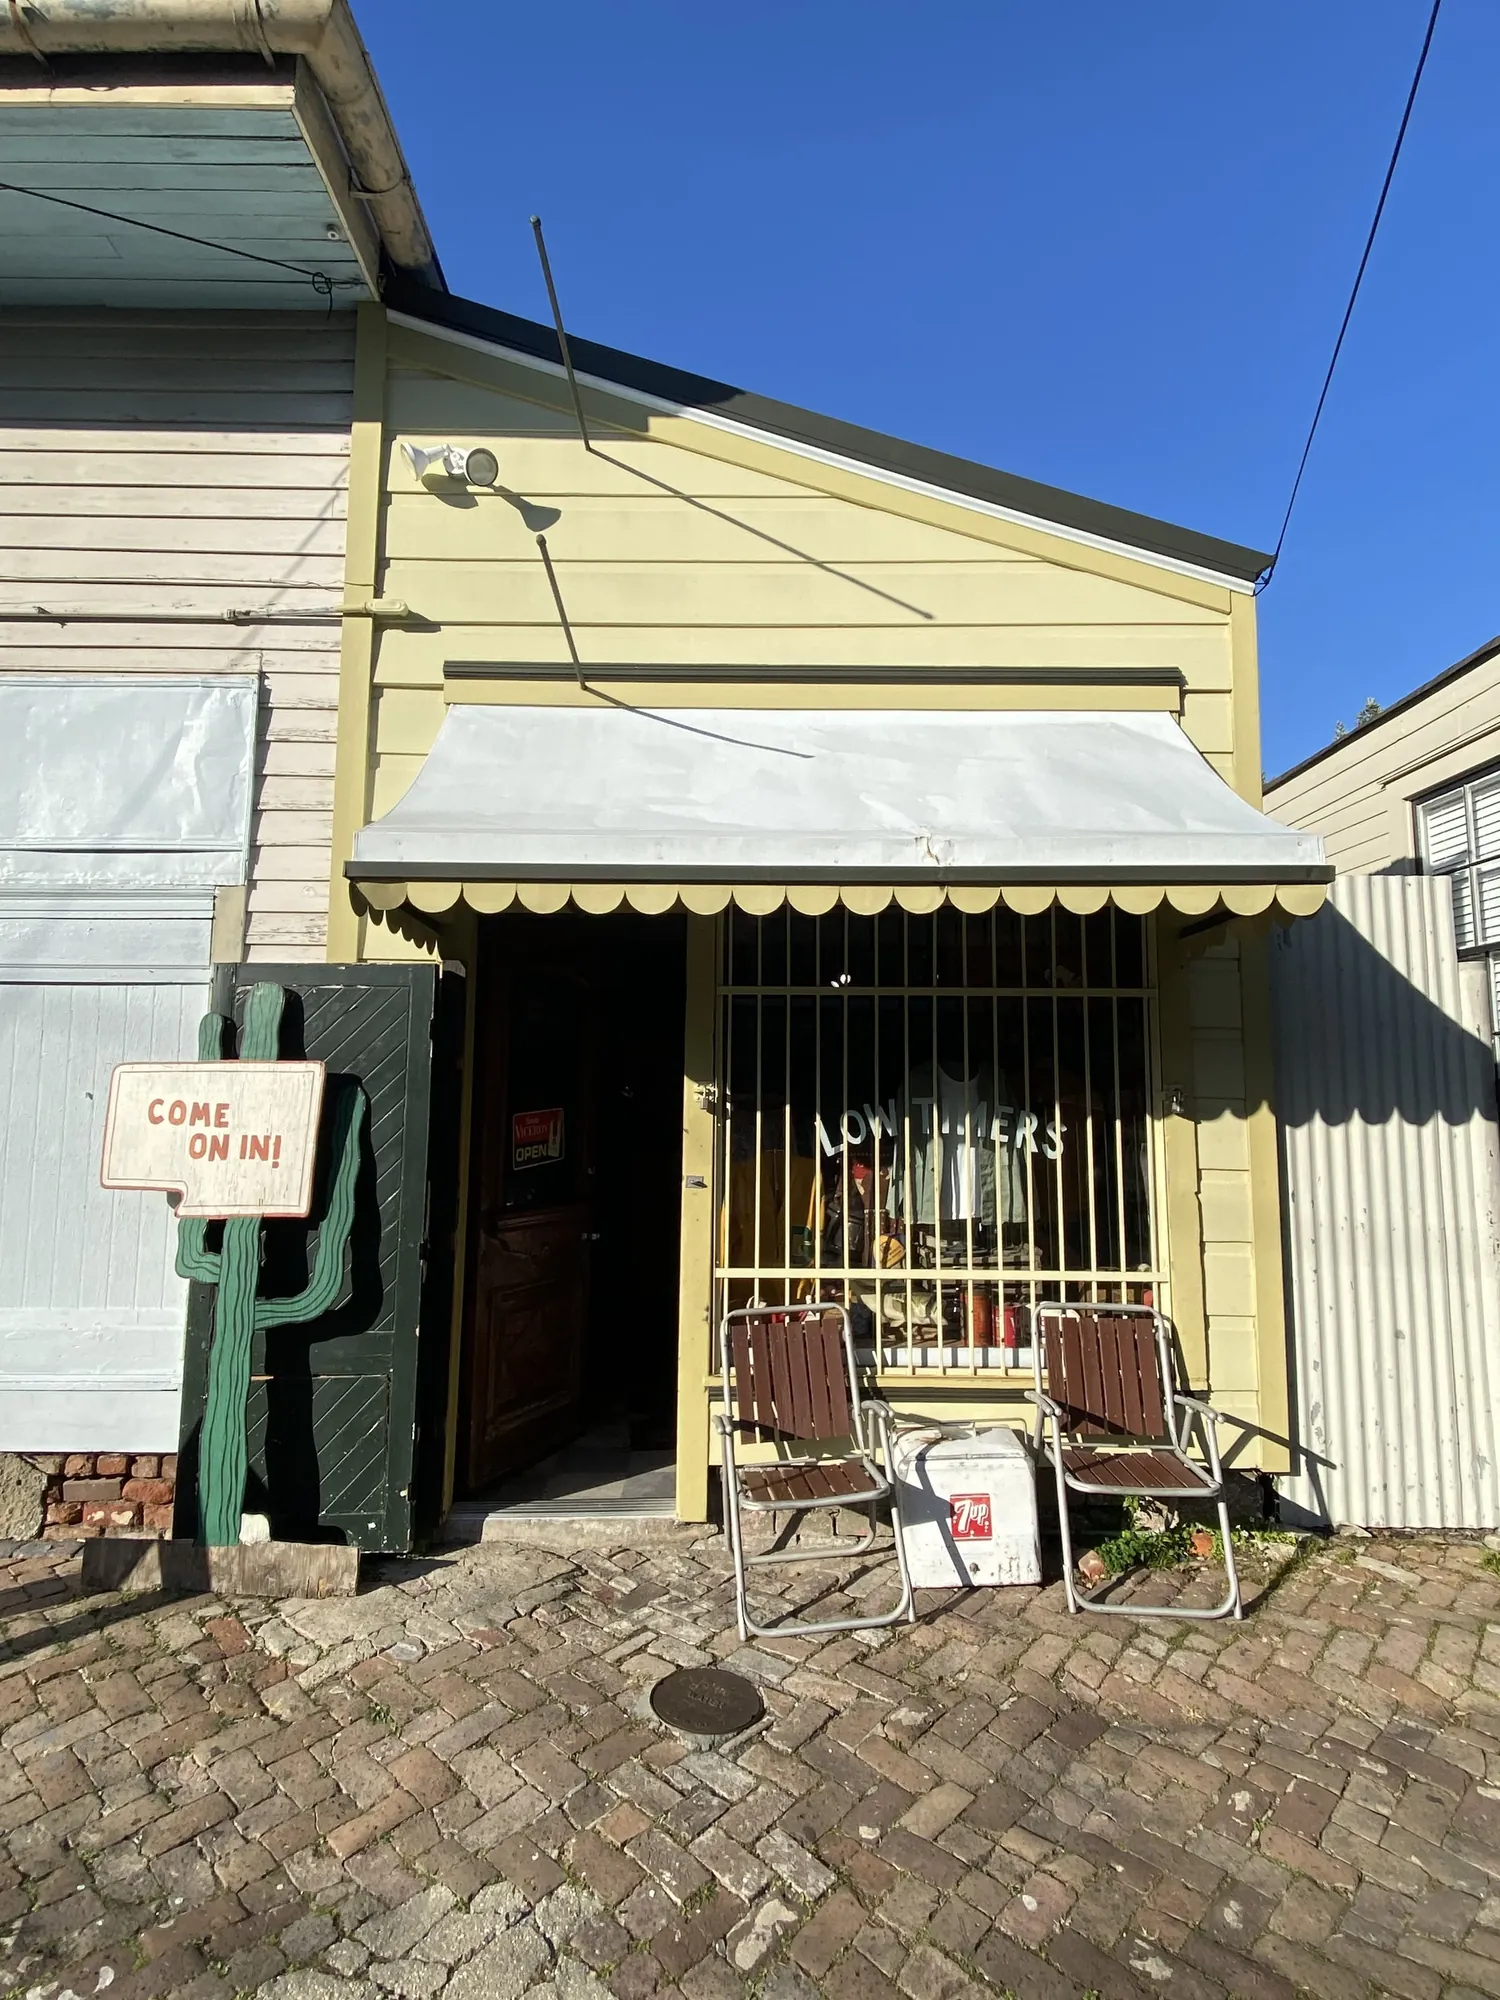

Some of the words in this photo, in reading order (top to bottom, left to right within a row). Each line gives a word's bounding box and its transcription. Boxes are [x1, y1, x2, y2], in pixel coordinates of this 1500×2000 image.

[147, 1098, 230, 1128] COME
[814, 1099, 897, 1157] LOW
[912, 1097, 1067, 1160] TIMERS
[189, 1133, 230, 1161] ON
[239, 1134, 282, 1169] IN!
[516, 1144, 548, 1162] OPEN
